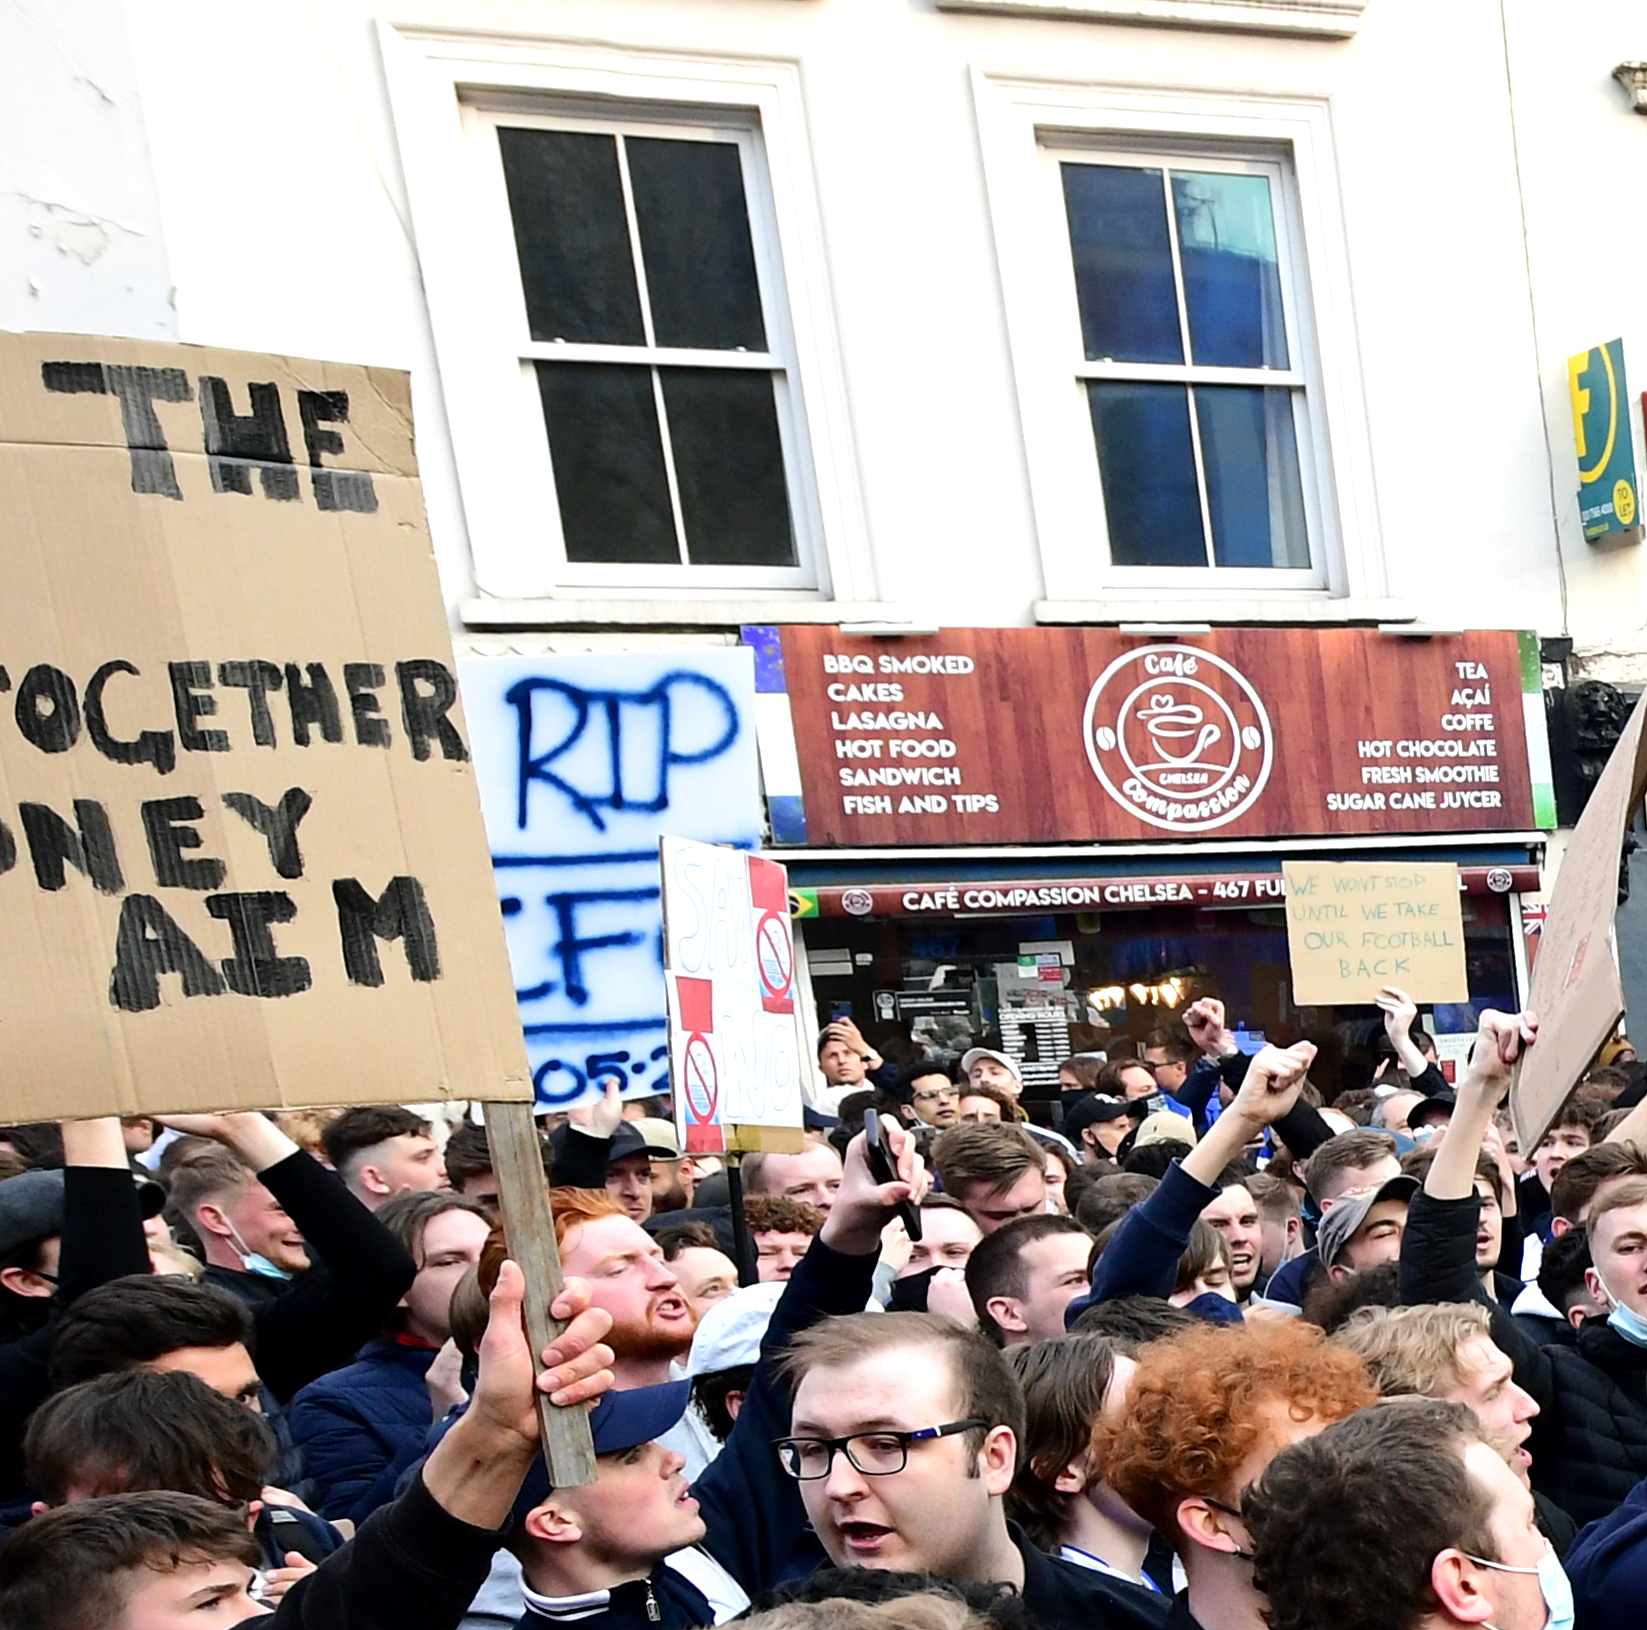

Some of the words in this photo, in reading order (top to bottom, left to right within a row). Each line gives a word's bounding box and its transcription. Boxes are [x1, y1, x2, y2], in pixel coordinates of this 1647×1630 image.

[41, 360, 379, 513] THE
[1617, 487, 1629, 501] TO
[823, 654, 875, 674] BBQ
[878, 655, 975, 674] SMOKED
[1144, 653, 1198, 676] Café
[1455, 662, 1488, 679] TEA
[827, 683, 904, 702] CAKES
[1450, 683, 1491, 709] AÇAÍ
[0, 658, 468, 774] OGETHER
[831, 711, 944, 730] LASAGNA
[1441, 714, 1494, 731] COFFE
[505, 670, 740, 832] RIP
[835, 739, 883, 758] HOT
[889, 739, 957, 758] FOOD
[1358, 740, 1393, 758] HOT
[1396, 739, 1497, 757] CHOCOLATE
[839, 767, 961, 786] SANDWICH
[1159, 772, 1208, 785] CHELSEA
[1361, 766, 1412, 783] FRESH
[1415, 765, 1499, 783] SMOOTHIE
[843, 795, 892, 814] FISH
[898, 795, 948, 813] AND
[951, 794, 999, 813] TIPS
[1122, 774, 1251, 821] Compassion
[1326, 793, 1386, 810] SUGAR
[1389, 792, 1436, 809] CANE
[1439, 791, 1501, 809] JUYCER
[1289, 874, 1318, 896] WE
[1333, 875, 1380, 893] WONT
[1384, 874, 1425, 889] STOP
[902, 886, 960, 911] CAFÉ
[963, 886, 1100, 909] COMPASSION
[1104, 883, 1193, 903] CHELSEA
[1213, 880, 1250, 898] 467
[1292, 904, 1349, 920] UNTIL
[1361, 903, 1388, 920] WE
[1394, 902, 1440, 917] TAKE
[109, 875, 442, 1012] AIM
[1304, 932, 1349, 950] OUR
[1361, 931, 1453, 949] FOOTBALL
[1339, 957, 1411, 978] BACK
